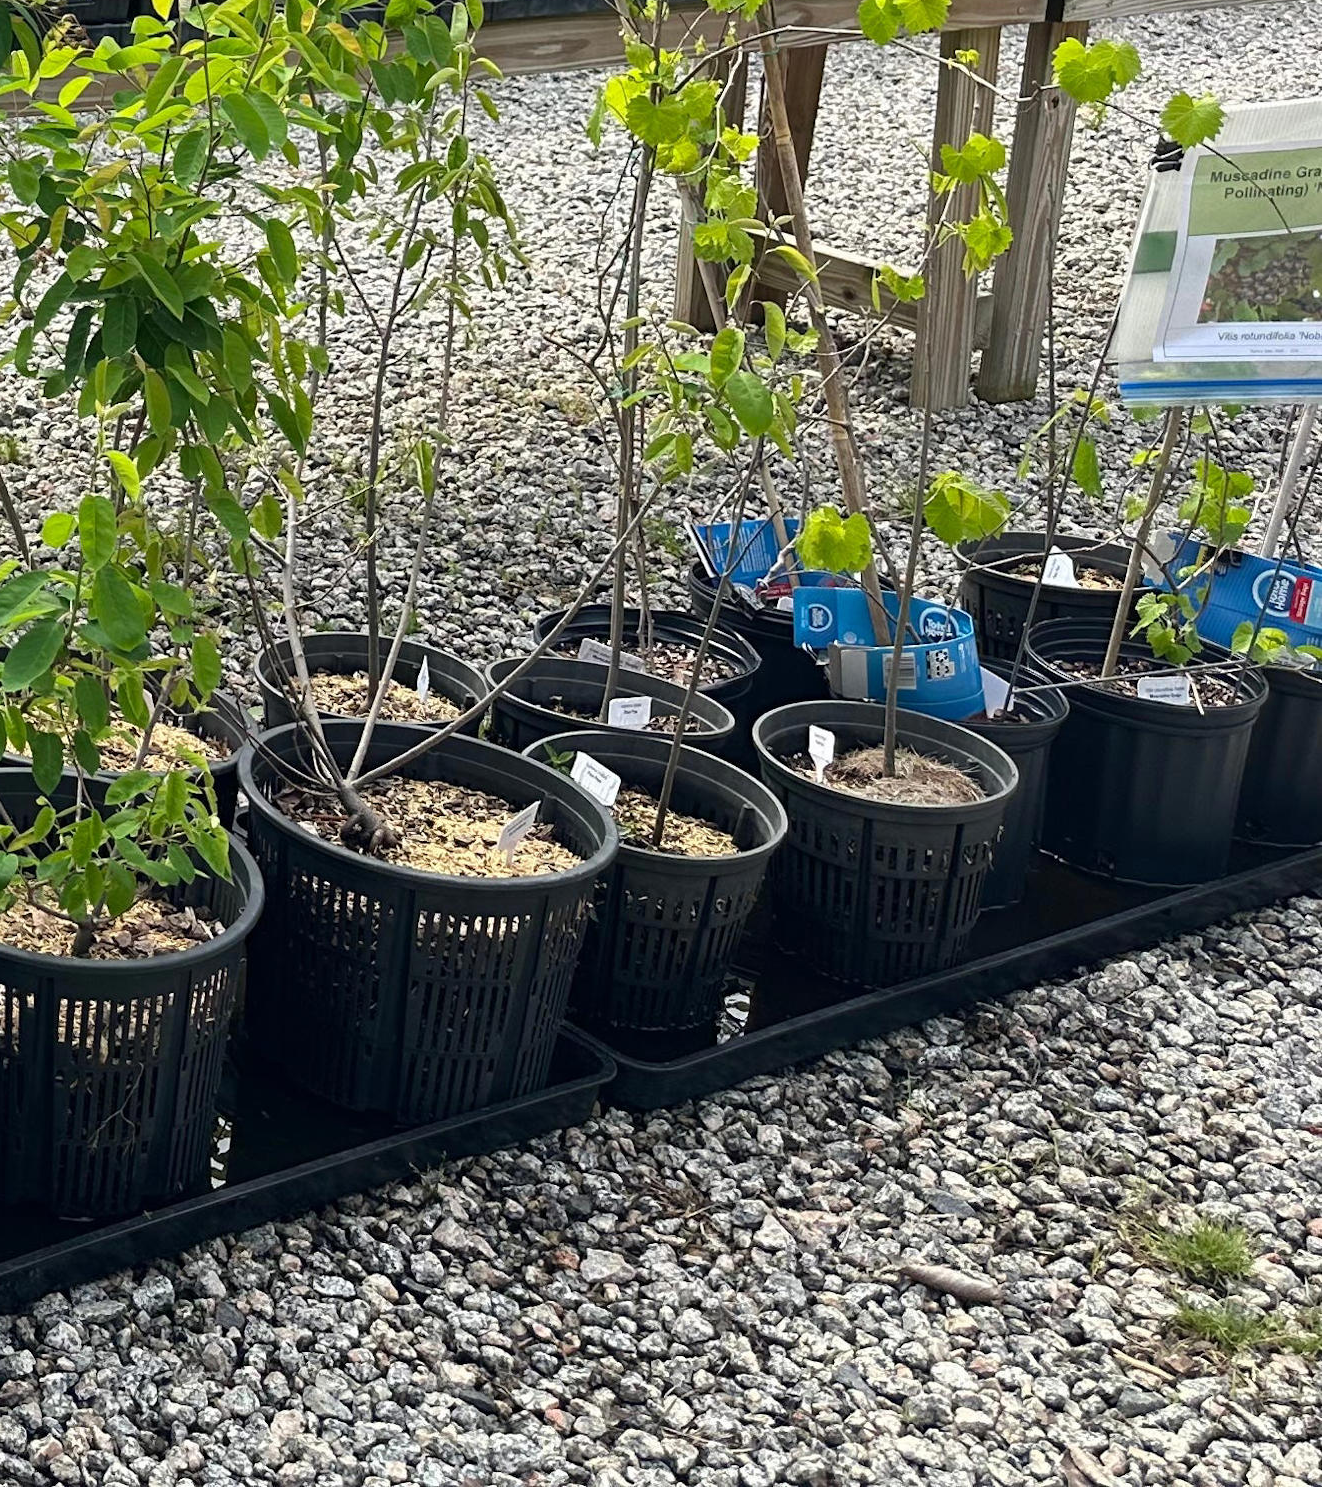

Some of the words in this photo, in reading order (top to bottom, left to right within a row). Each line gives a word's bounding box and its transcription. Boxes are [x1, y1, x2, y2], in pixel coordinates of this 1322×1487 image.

[1209, 168, 1292, 183] Muscadine
[1224, 182, 1309, 200] Pollinating)
[1217, 331, 1238, 341] Vitis
[1274, 578, 1290, 611] Home
